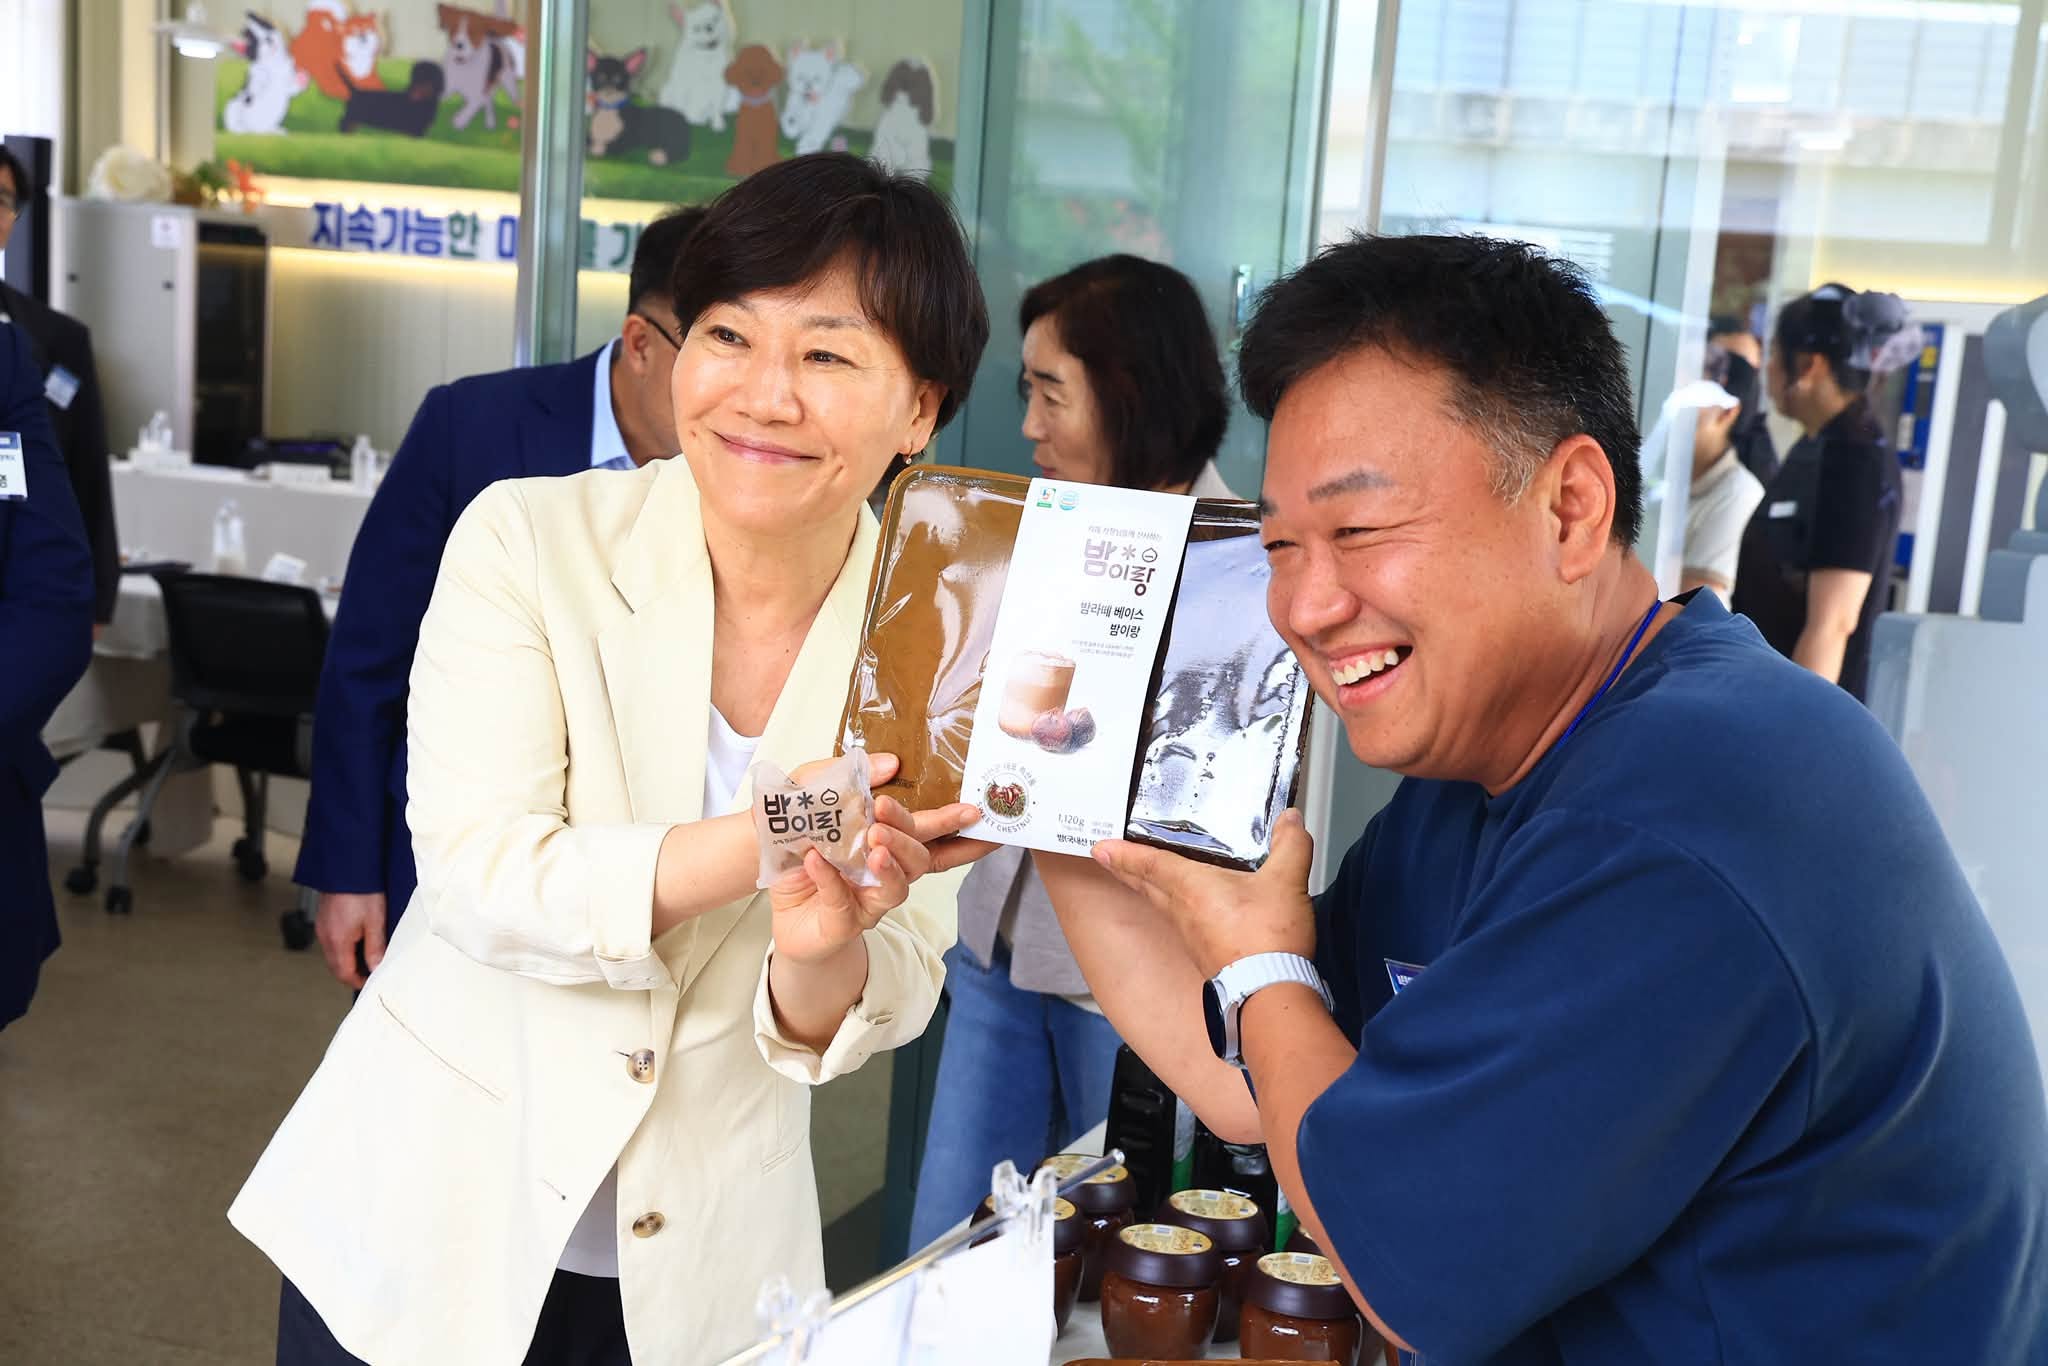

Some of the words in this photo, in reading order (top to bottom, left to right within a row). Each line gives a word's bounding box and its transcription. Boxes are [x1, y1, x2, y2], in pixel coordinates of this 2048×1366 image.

[311, 202, 481, 259] 지속가능한
[1113, 606, 1144, 620] 베이스
[1110, 623, 1141, 639] 밤이랑
[764, 791, 842, 842] 밤이랑
[996, 812, 1033, 833] CHESTNUT
[1058, 813, 1085, 827] 1,120g
